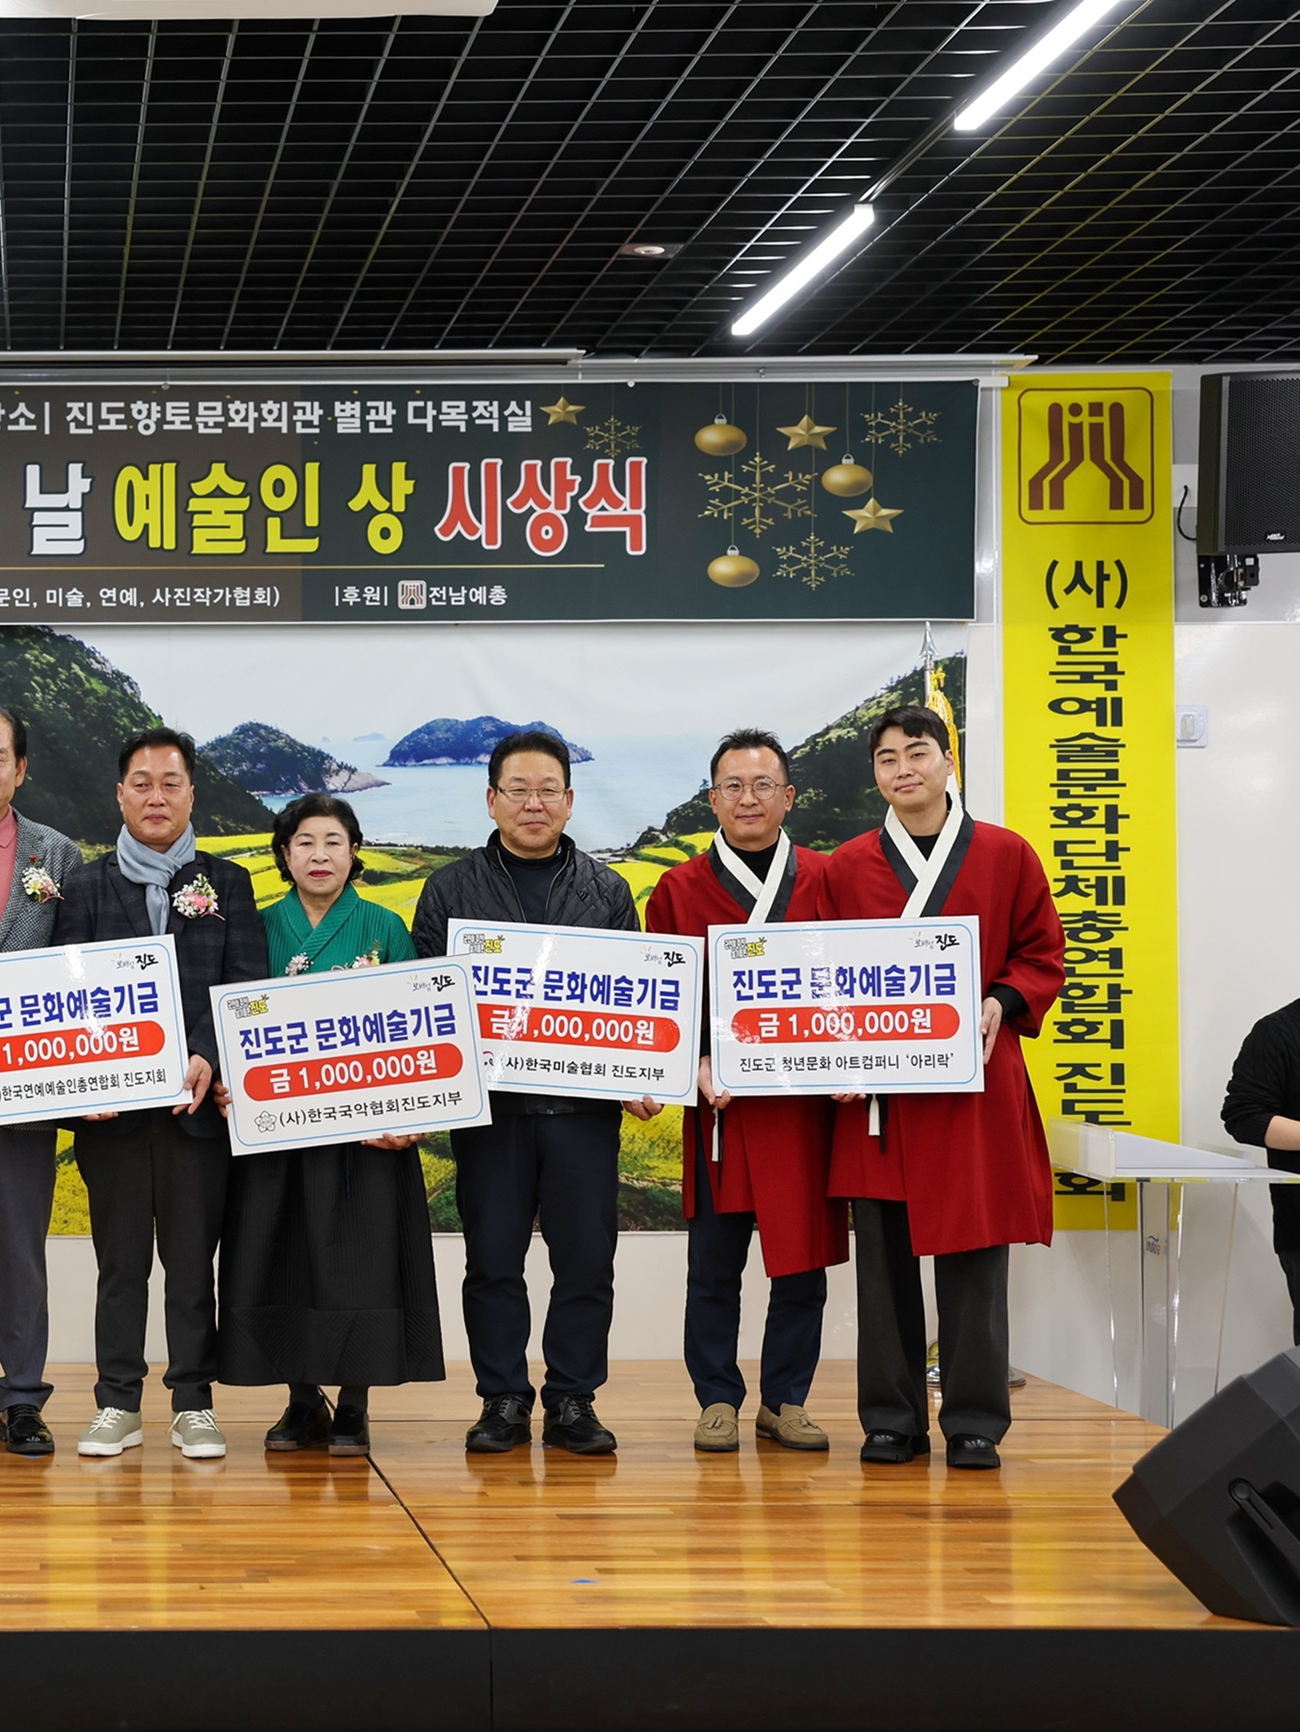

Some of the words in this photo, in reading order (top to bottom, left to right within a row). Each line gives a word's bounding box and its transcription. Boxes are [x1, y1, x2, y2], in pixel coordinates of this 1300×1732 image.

[66, 401, 323, 434] 진도향토문화회관
[334, 401, 397, 434] 별관
[406, 400, 533, 433] 다목적실
[24, 461, 92, 556] 날
[113, 460, 321, 556] 예술인
[347, 460, 415, 555] 상
[434, 455, 648, 557] 시상식
[46, 588, 90, 609] 미술,
[99, 588, 144, 609] 연예,
[152, 587, 280, 610] 사진작가협회)
[428, 586, 508, 606] 전남예총
[1047, 624, 1133, 1050] 한국예술문화단체총연합회
[935, 933, 960, 951] 진도
[135, 953, 159, 970] 진도
[663, 951, 686, 967] 진도
[431, 974, 456, 992] 진도
[472, 965, 536, 999] 진도군
[543, 970, 681, 1011] 문화예술기금
[733, 967, 803, 1001] 진도군
[810, 963, 957, 999] 문화예술기금
[20, 981, 159, 1027] 문화예술기금
[239, 1021, 309, 1060] 진도군
[316, 1003, 457, 1050] 문화예술기금
[490, 1009, 510, 1034] 금
[758, 1012, 780, 1037] 금
[788, 1008, 932, 1038] 1,000,000원
[2, 1027, 140, 1065] 1,000,000원
[124, 1068, 167, 1087] 진도지회
[270, 1068, 291, 1094] 금
[299, 1050, 438, 1090] 1,000,000원
[501, 1055, 607, 1077] 사)한국미술협회
[612, 1064, 666, 1081] 진도지부
[739, 1057, 776, 1073] 진도군
[782, 1055, 832, 1072] 청년문화
[836, 1054, 900, 1071] 아트컴퍼니
[279, 1091, 463, 1126] (사)한국국악협회진도지부
[1054, 1062, 1132, 1202] 진도회
